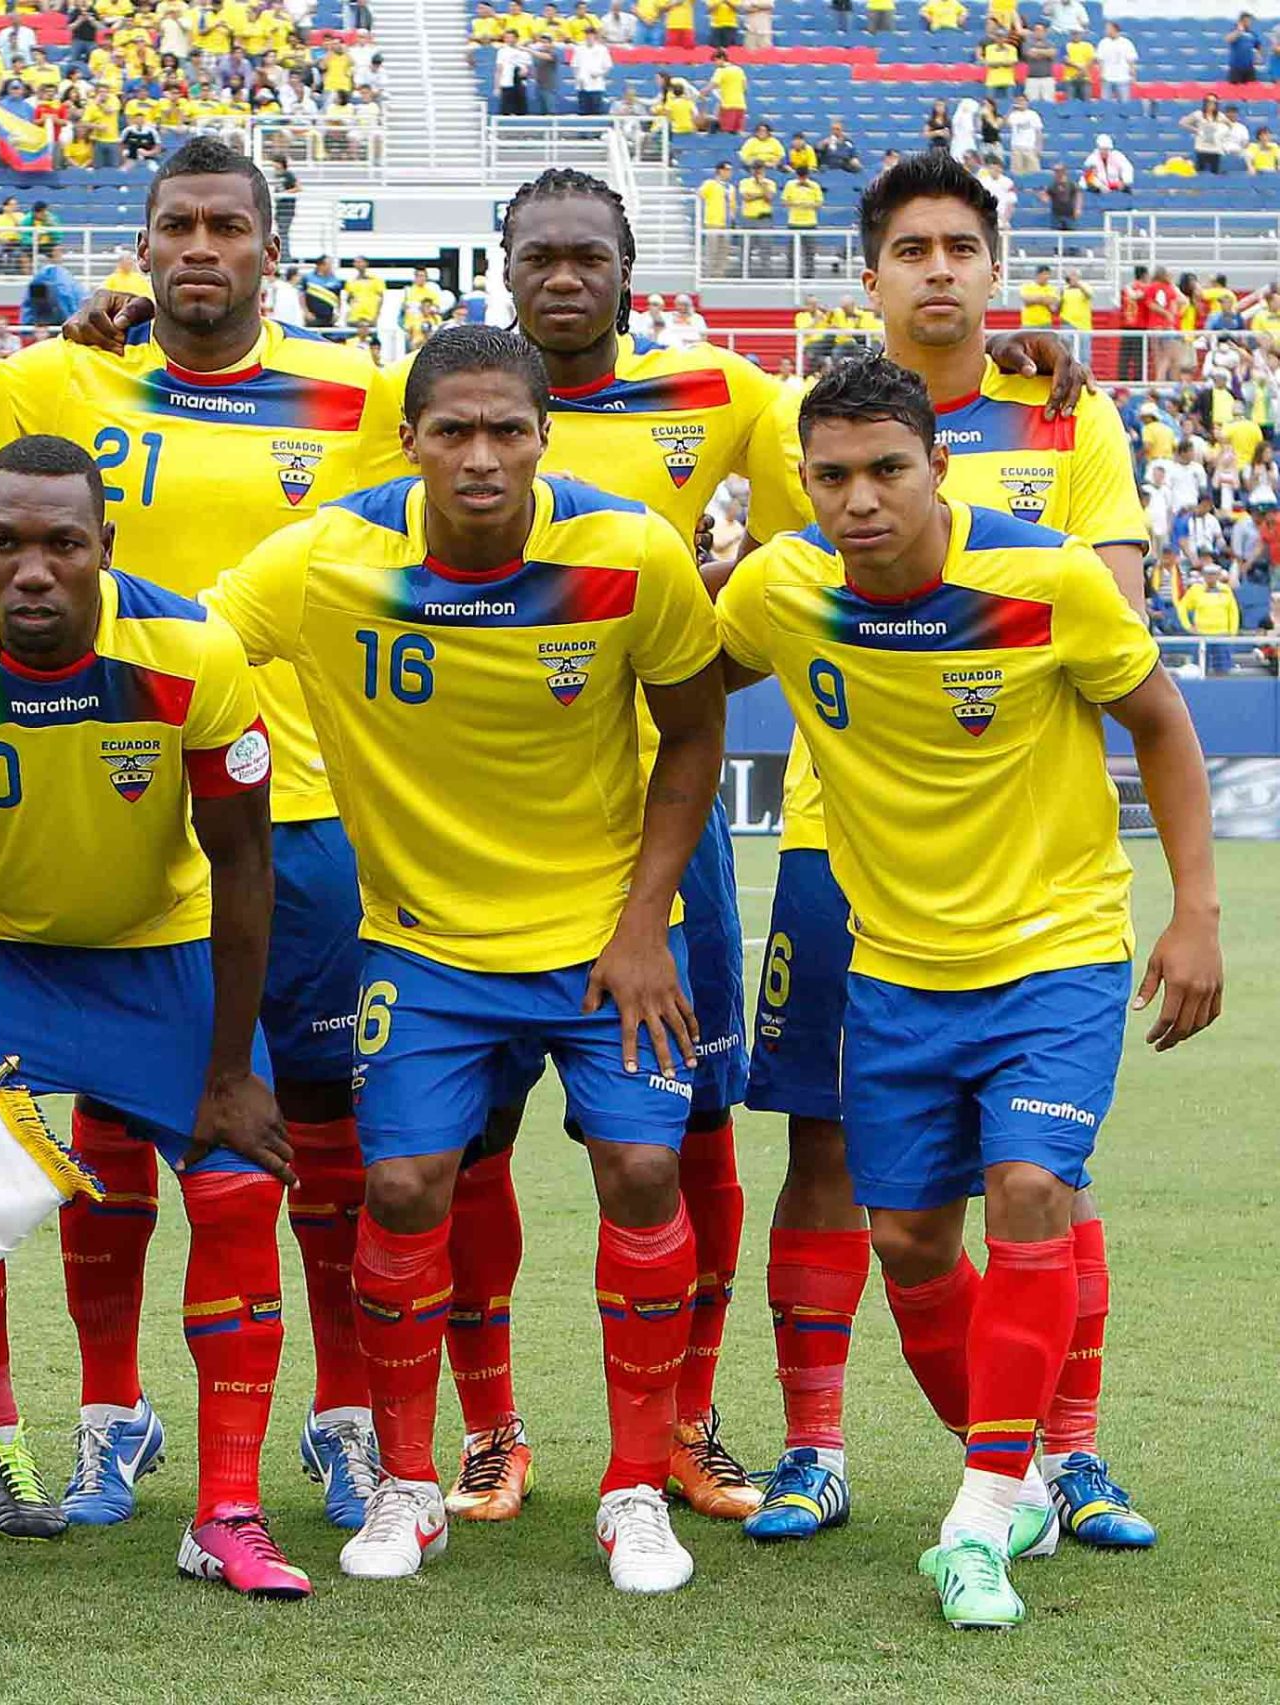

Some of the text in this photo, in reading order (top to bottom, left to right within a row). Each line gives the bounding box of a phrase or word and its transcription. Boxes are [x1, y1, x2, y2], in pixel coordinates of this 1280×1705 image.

[169, 393, 256, 414] marathon
[651, 425, 705, 437] ECUADOR
[271, 440, 324, 454] ECUADOR
[93, 426, 163, 507] 21
[1000, 467, 1055, 477] ECUADOR
[424, 600, 516, 616] marathon
[858, 619, 948, 636] marathon
[538, 640, 597, 654] ECUADOR
[355, 629, 436, 705] 16
[942, 669, 1003, 683] ECUADOR
[808, 658, 849, 730] 9
[11, 694, 100, 715] marathon
[101, 740, 161, 751] ECUADOR
[765, 932, 793, 1007] 6
[312, 1014, 360, 1034] mara
[694, 1033, 740, 1057] arathon
[1010, 1097, 1096, 1127] marathon
[454, 1362, 508, 1381] arathon
